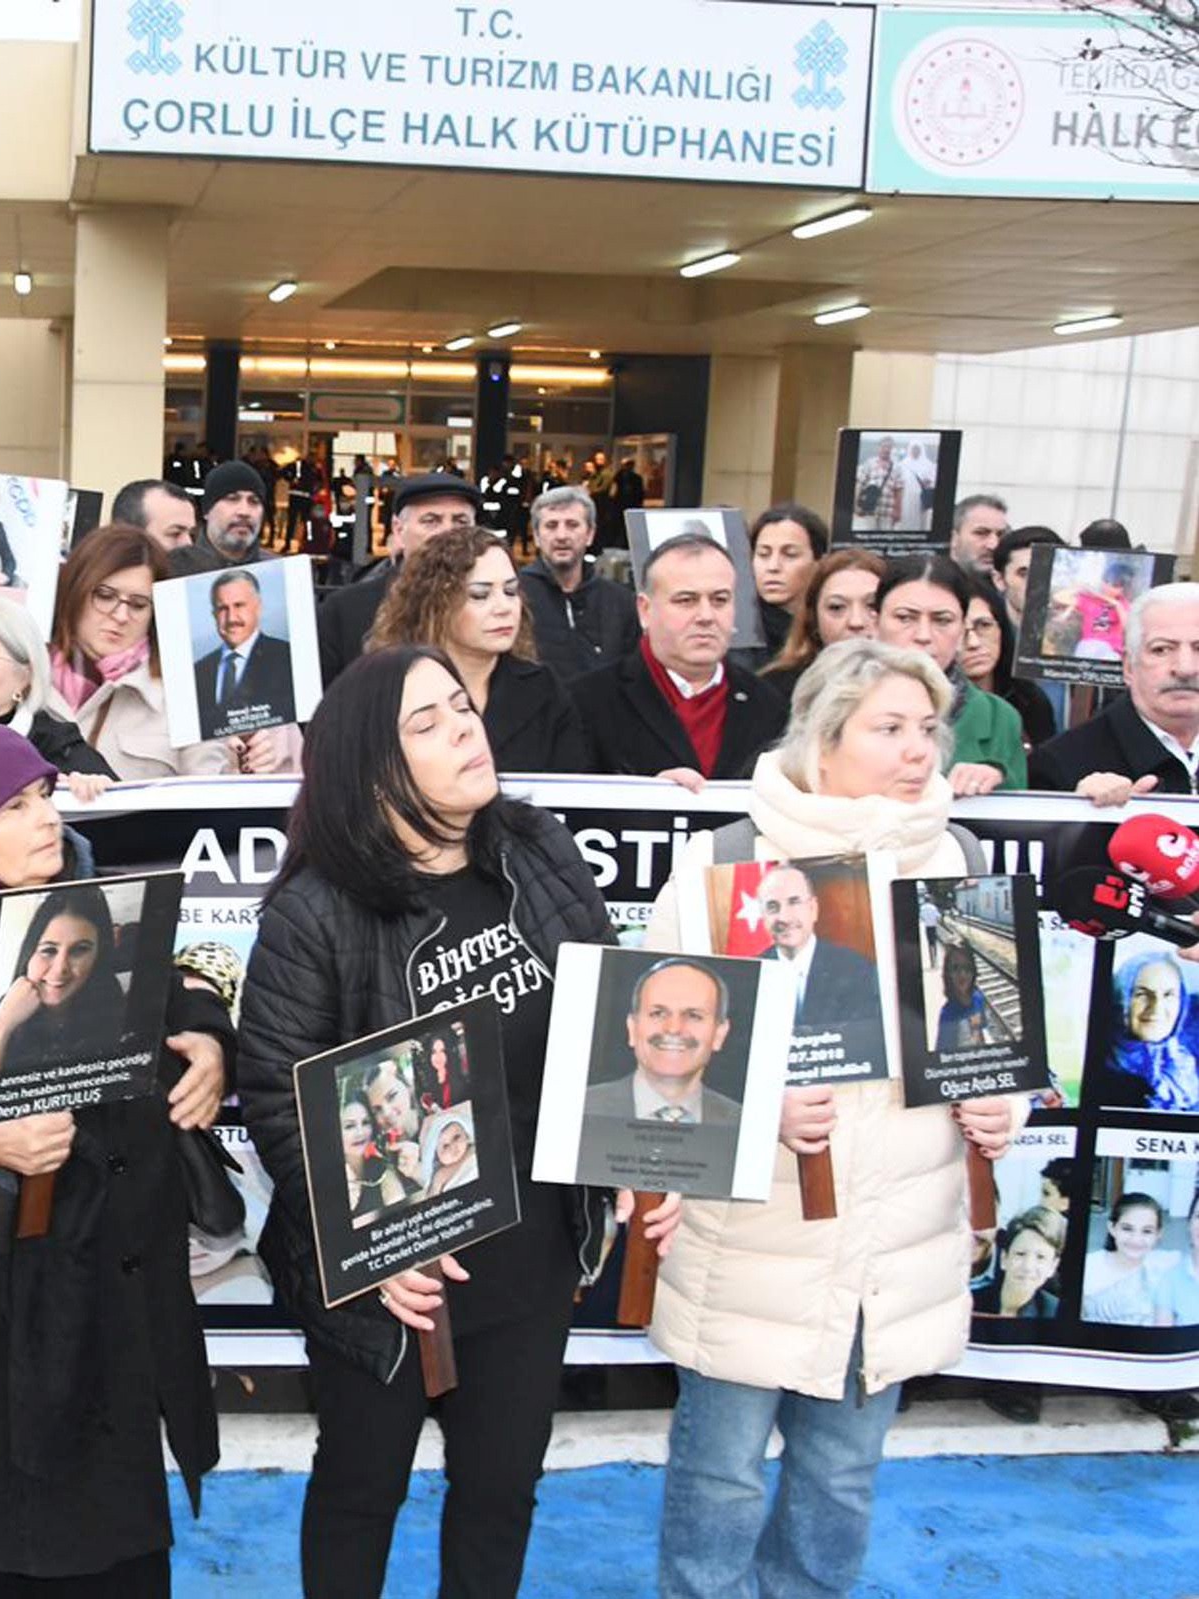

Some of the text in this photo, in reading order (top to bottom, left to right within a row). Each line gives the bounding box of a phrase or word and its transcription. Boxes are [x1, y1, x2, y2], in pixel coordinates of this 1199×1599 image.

[455, 8, 523, 39] T.C.
[194, 36, 772, 104] KÜLTÜR VE TURİZM BAKANLIĞI
[122, 97, 837, 168] ÇORLU İLÇE HALK KÜTÜPHANESİ
[1052, 110, 1159, 149] HALK
[181, 827, 288, 884] AD
[0, 1072, 43, 1088] annesiz
[43, 1070, 57, 1080] ve
[58, 1061, 106, 1078] kardeşsiz
[106, 1052, 152, 1072] geçirdiği
[940, 1072, 1017, 1099] Oğuz Arda SEL
[20, 1083, 66, 1099] hesabını
[32, 1087, 102, 1112] KURTULUŞ
[1046, 1133, 1069, 1146] SEL
[1136, 1136, 1188, 1154] SENA
[370, 1227, 384, 1242] Bir
[384, 1219, 409, 1237] aileyi
[407, 1211, 424, 1229] yok
[340, 1250, 370, 1271] geride
[406, 1226, 422, 1242] hiç
[384, 1245, 414, 1266] Devlet
[413, 1235, 440, 1253] Demir
